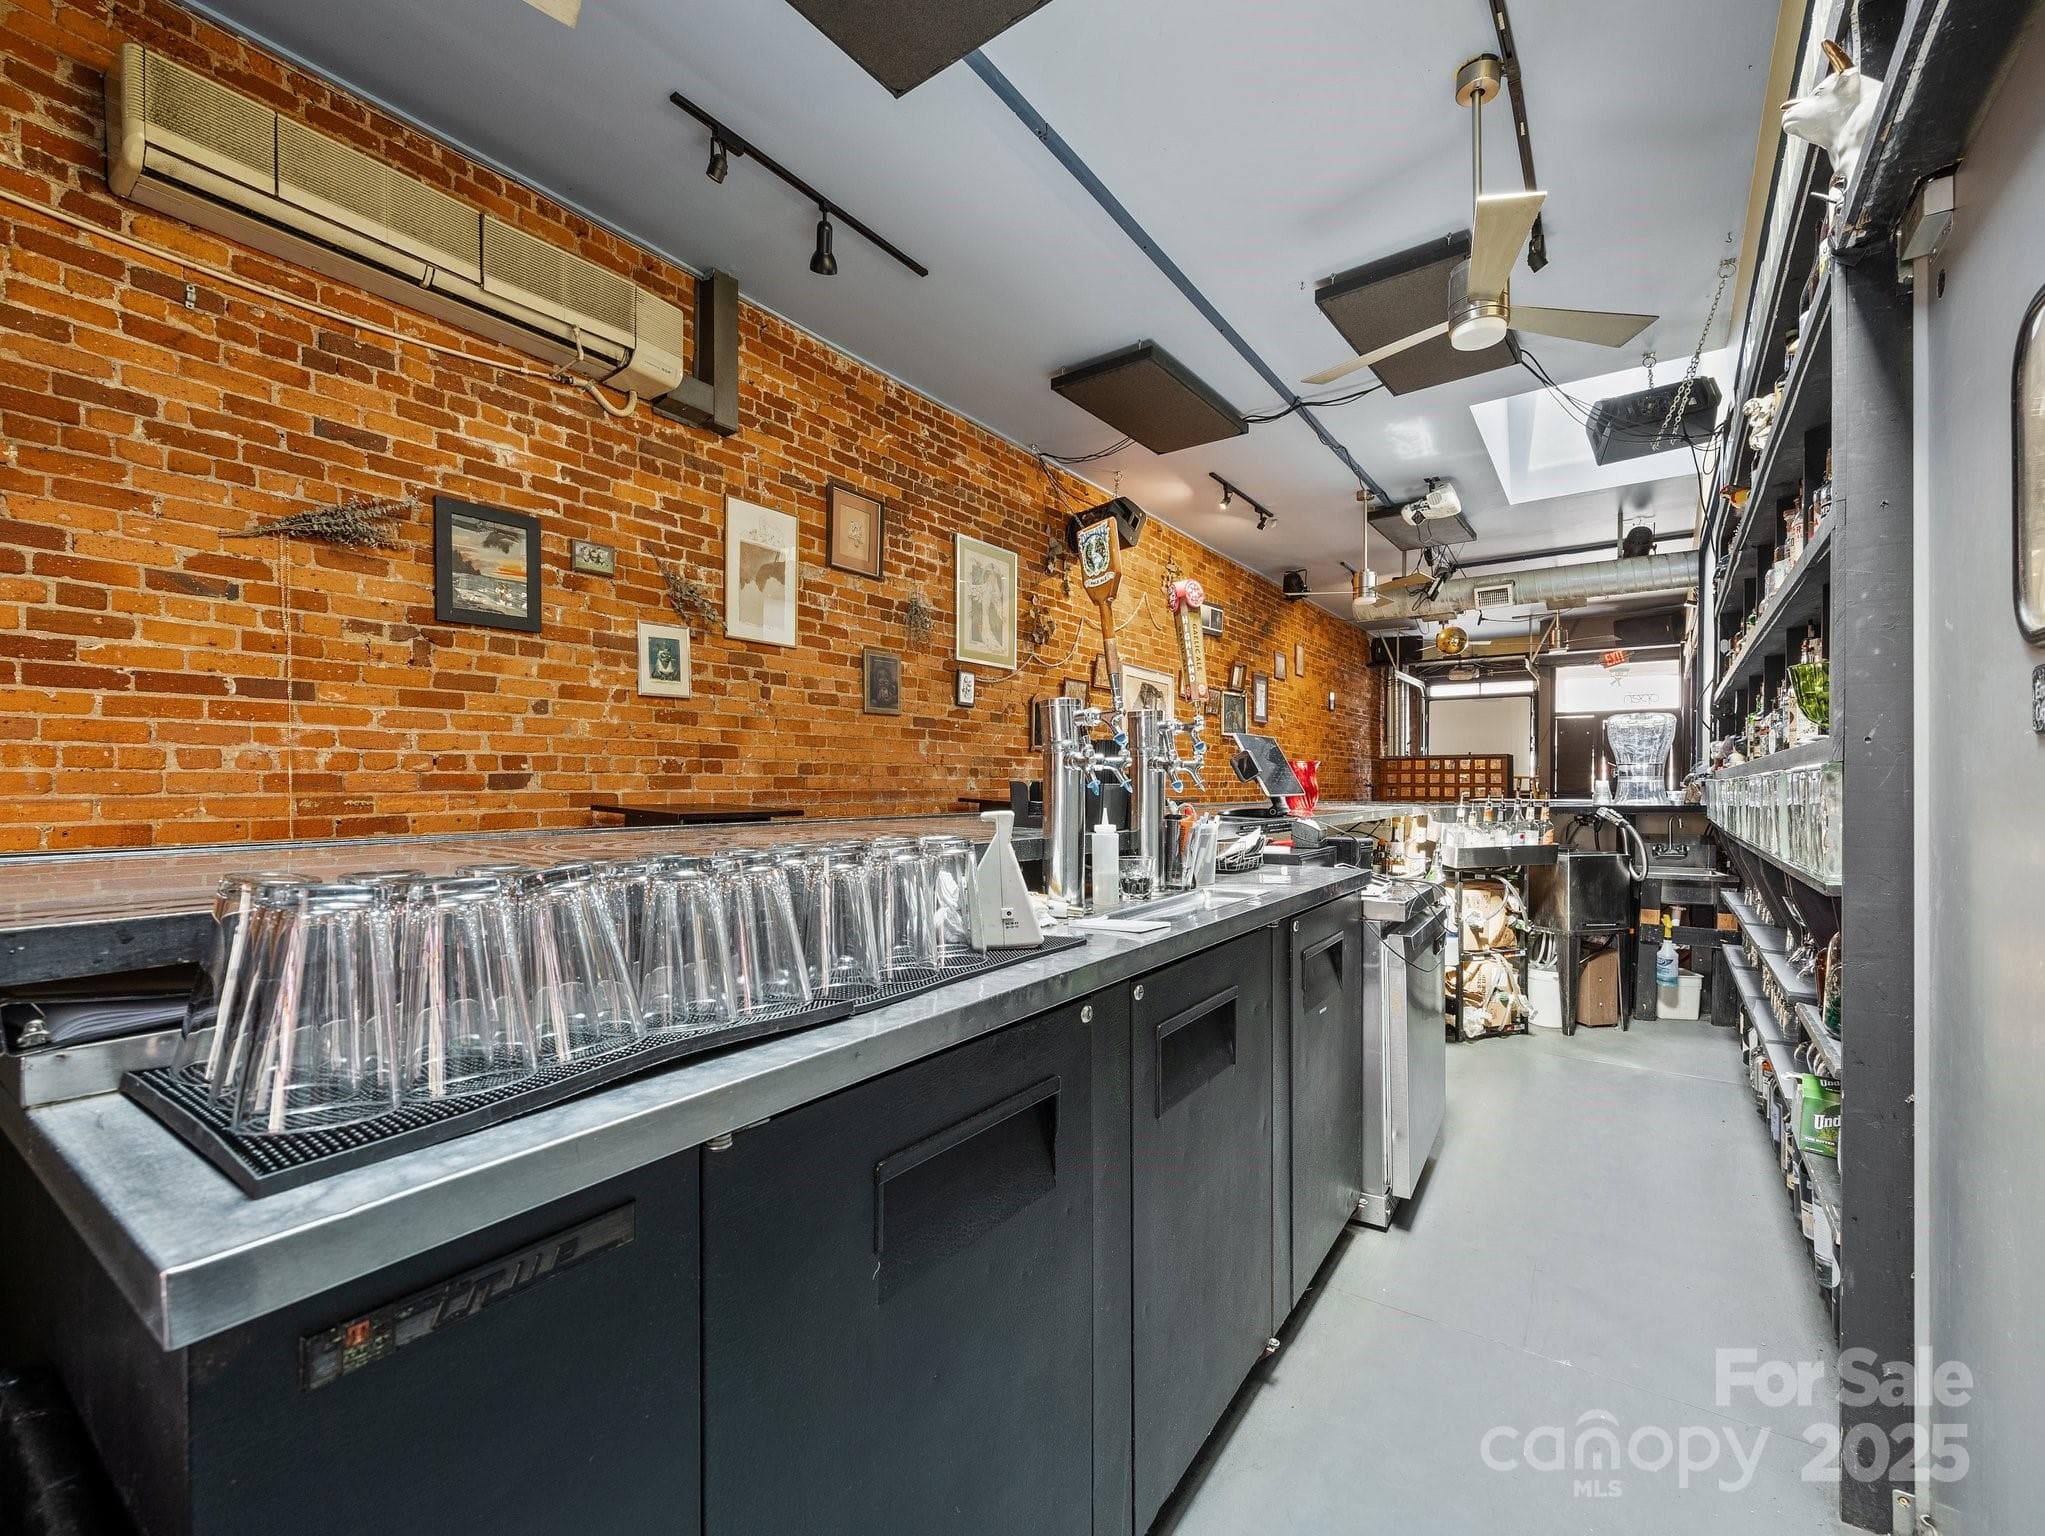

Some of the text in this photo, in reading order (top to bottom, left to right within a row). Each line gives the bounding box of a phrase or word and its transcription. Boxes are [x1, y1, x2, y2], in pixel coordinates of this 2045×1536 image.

[1182, 615, 1196, 683] HIGHLAND
[1192, 623, 1201, 655] GAELIC
[1605, 650, 1625, 666] EXIT
[1814, 1114, 1841, 1130] Und
